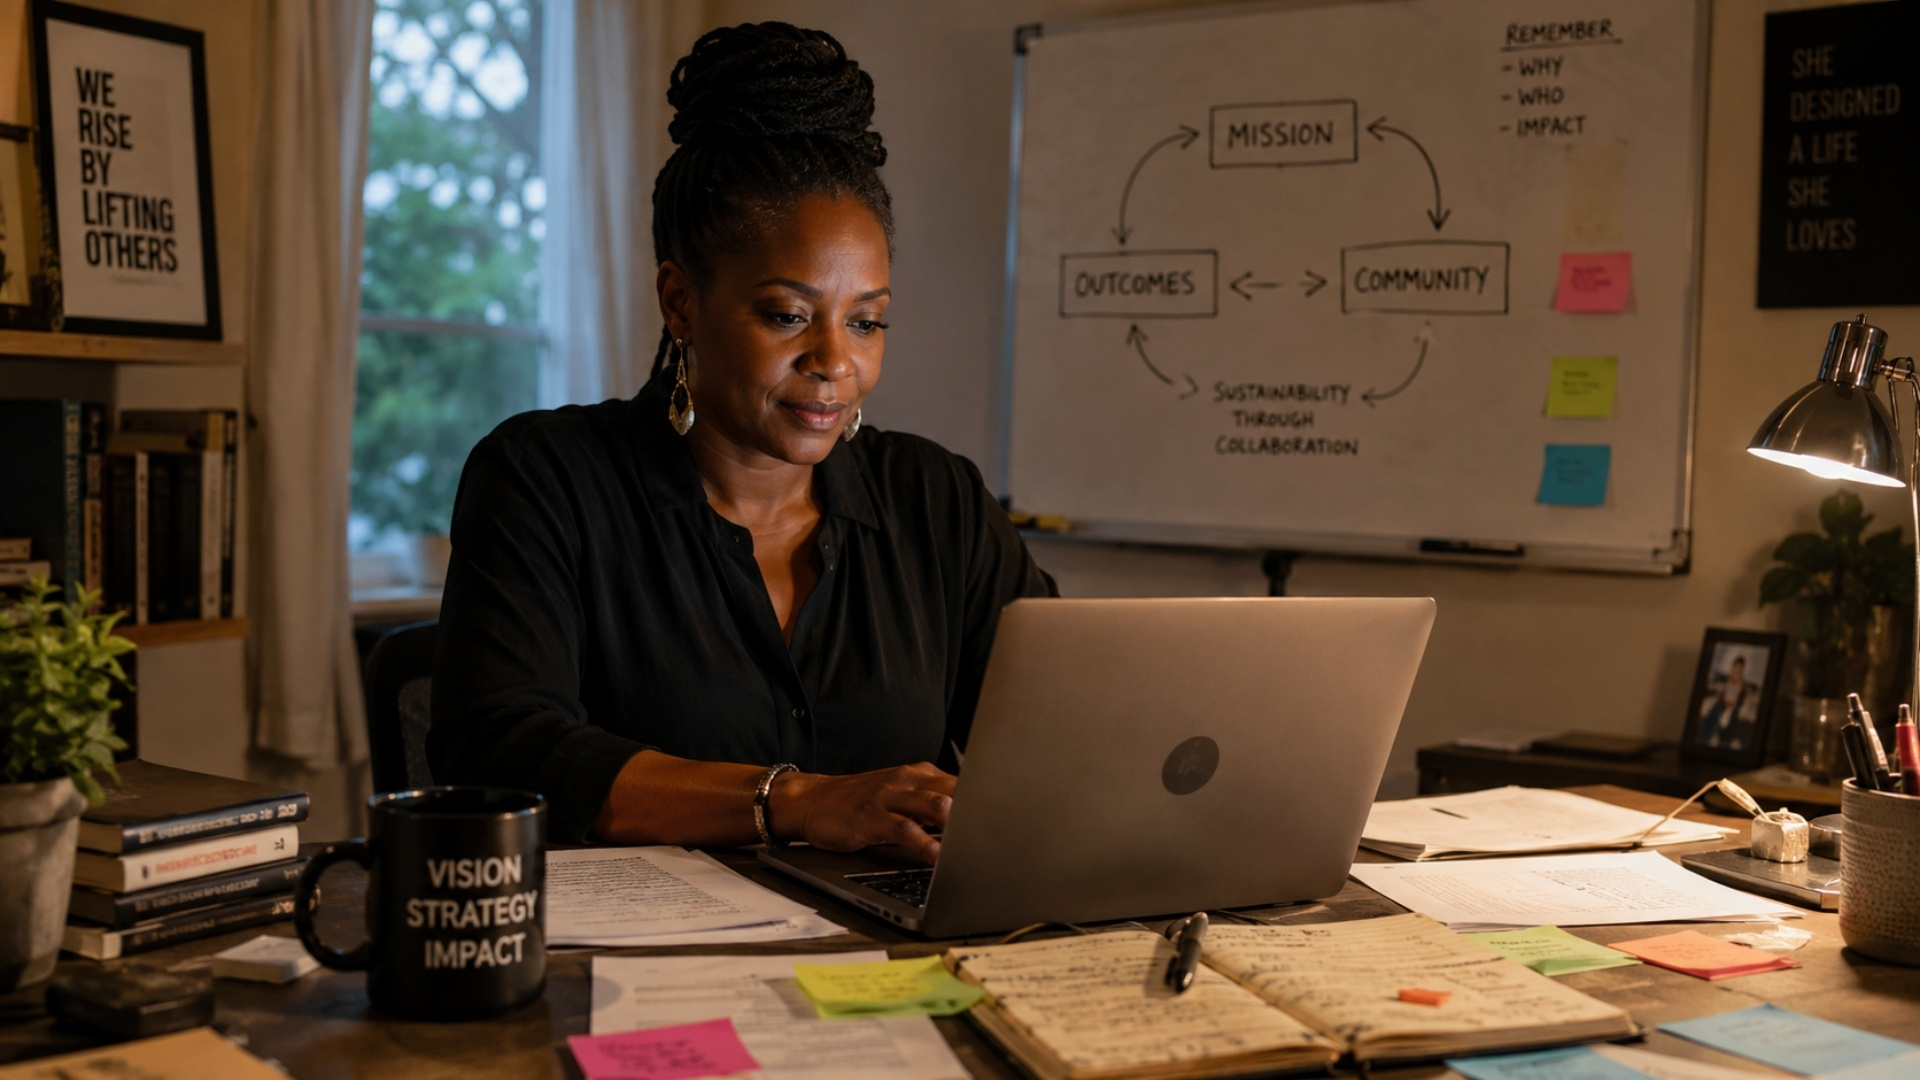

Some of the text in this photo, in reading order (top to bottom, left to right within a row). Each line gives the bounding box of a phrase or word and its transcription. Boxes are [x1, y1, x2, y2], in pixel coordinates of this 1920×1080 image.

[1505, 19, 1614, 44] REMEMBER
[1518, 56, 1564, 77] WHY
[1791, 44, 1834, 78] SHE
[75, 67, 115, 107] WE
[1517, 87, 1565, 106] WHO
[1790, 84, 1901, 122] DESIGNED
[78, 108, 133, 149] RISE
[1227, 121, 1334, 150] MISSION
[1516, 115, 1586, 138] IMPACT
[1788, 131, 1859, 164] A LIFE
[81, 149, 112, 186] BY
[1787, 175, 1831, 208] SHE
[83, 189, 174, 232] LIFTING
[85, 230, 178, 272] OTHERS
[1786, 219, 1857, 252] LOVES
[1075, 270, 1196, 298] OUTCOMES
[1354, 265, 1490, 295] COMMUNITY
[1213, 382, 1353, 405] SUSTAINABILITY
[1233, 409, 1315, 429] THROUGH
[1215, 436, 1359, 456] COLLABORATION
[427, 855, 523, 888] VISION
[406, 890, 538, 929] STRATEGY
[424, 933, 526, 969] IMPACT
